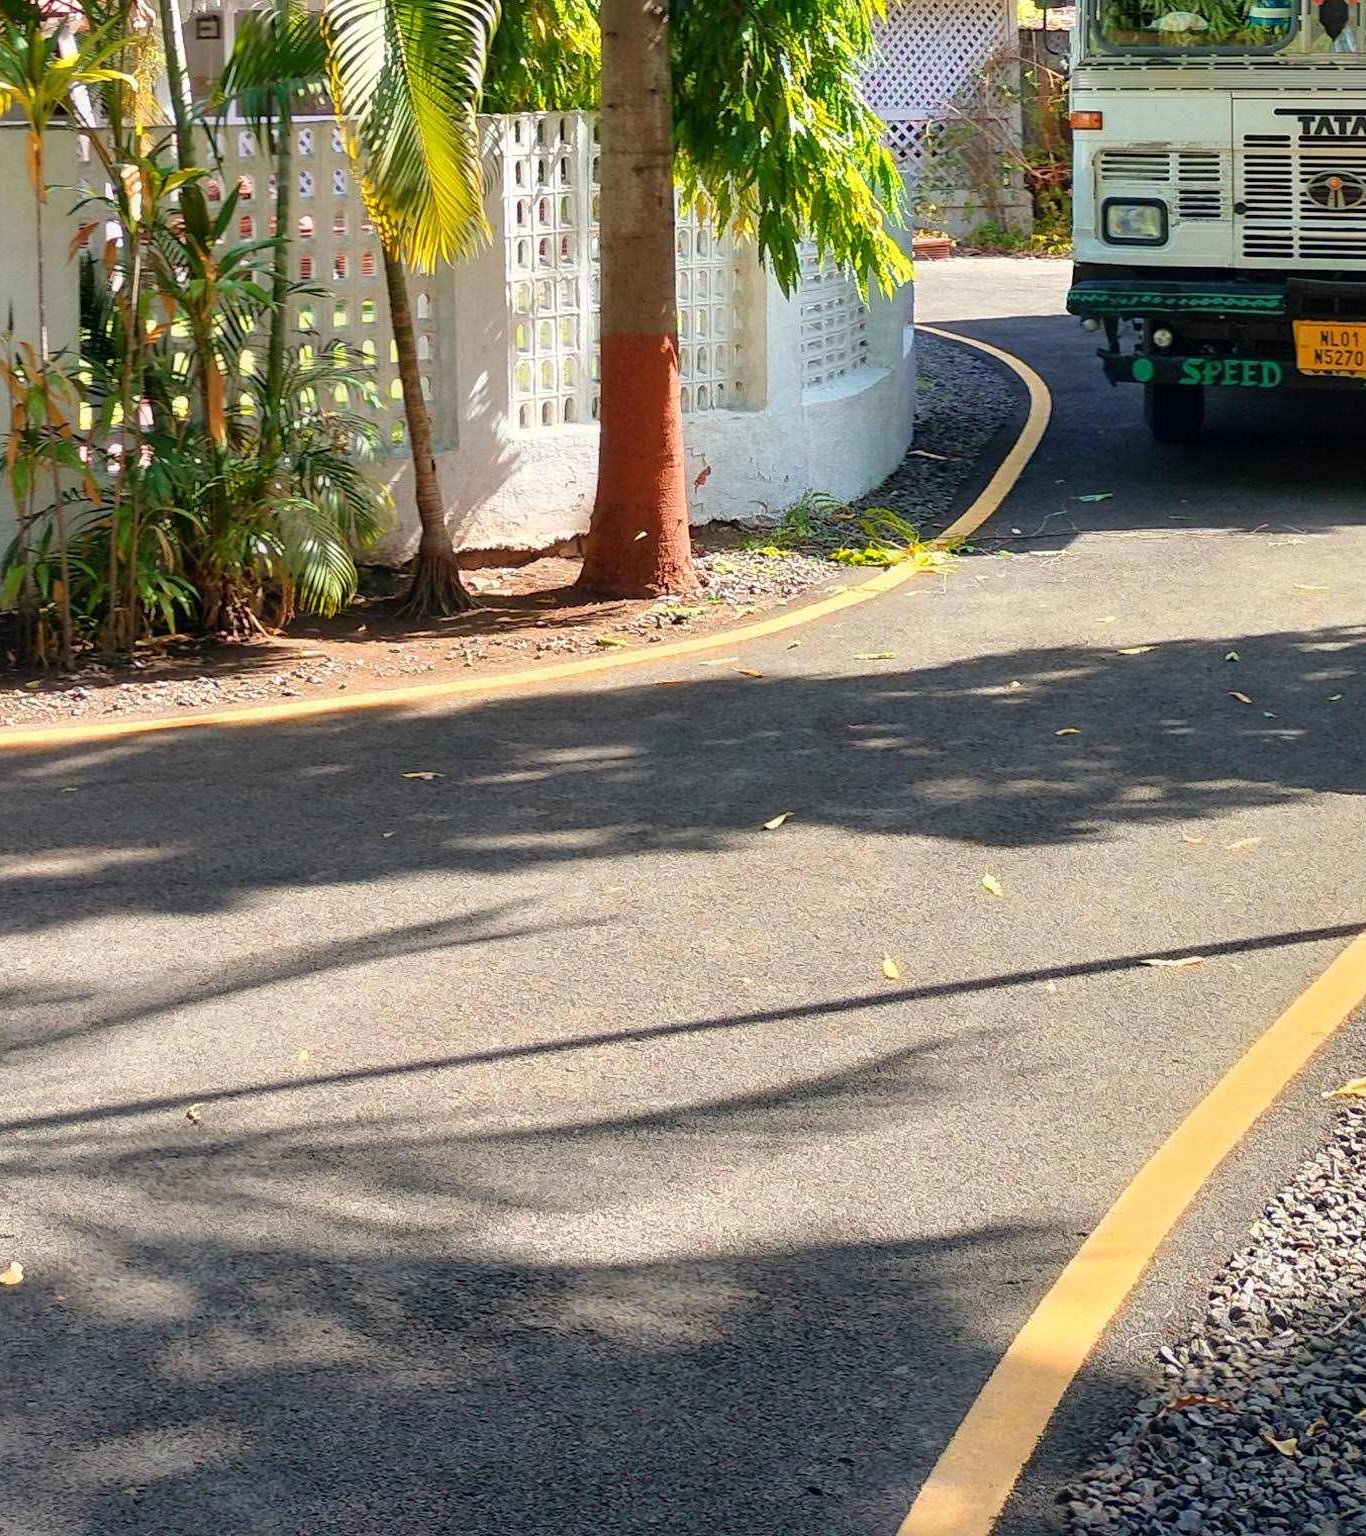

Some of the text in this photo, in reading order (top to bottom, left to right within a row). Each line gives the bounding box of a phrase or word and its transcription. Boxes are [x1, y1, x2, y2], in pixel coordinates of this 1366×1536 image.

[1320, 331, 1359, 346] NL01
[1315, 349, 1364, 366] N5270
[1178, 358, 1282, 388] SPEED
